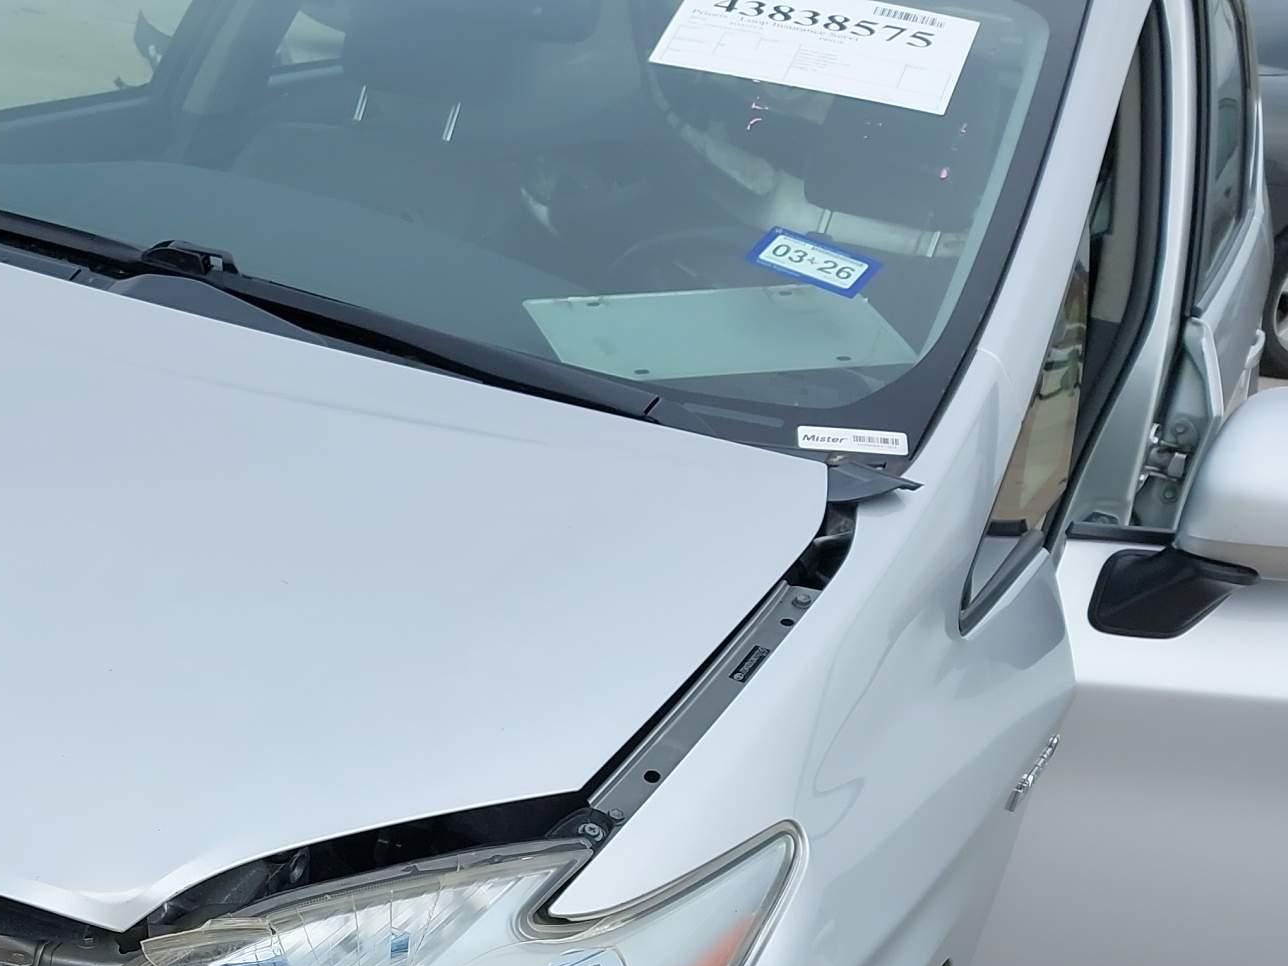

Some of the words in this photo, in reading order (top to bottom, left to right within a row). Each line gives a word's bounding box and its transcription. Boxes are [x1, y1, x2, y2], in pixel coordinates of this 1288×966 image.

[714, 0, 935, 48] 43838575
[772, 244, 808, 263] 03
[816, 260, 855, 280] 26
[802, 434, 847, 444] Mister
